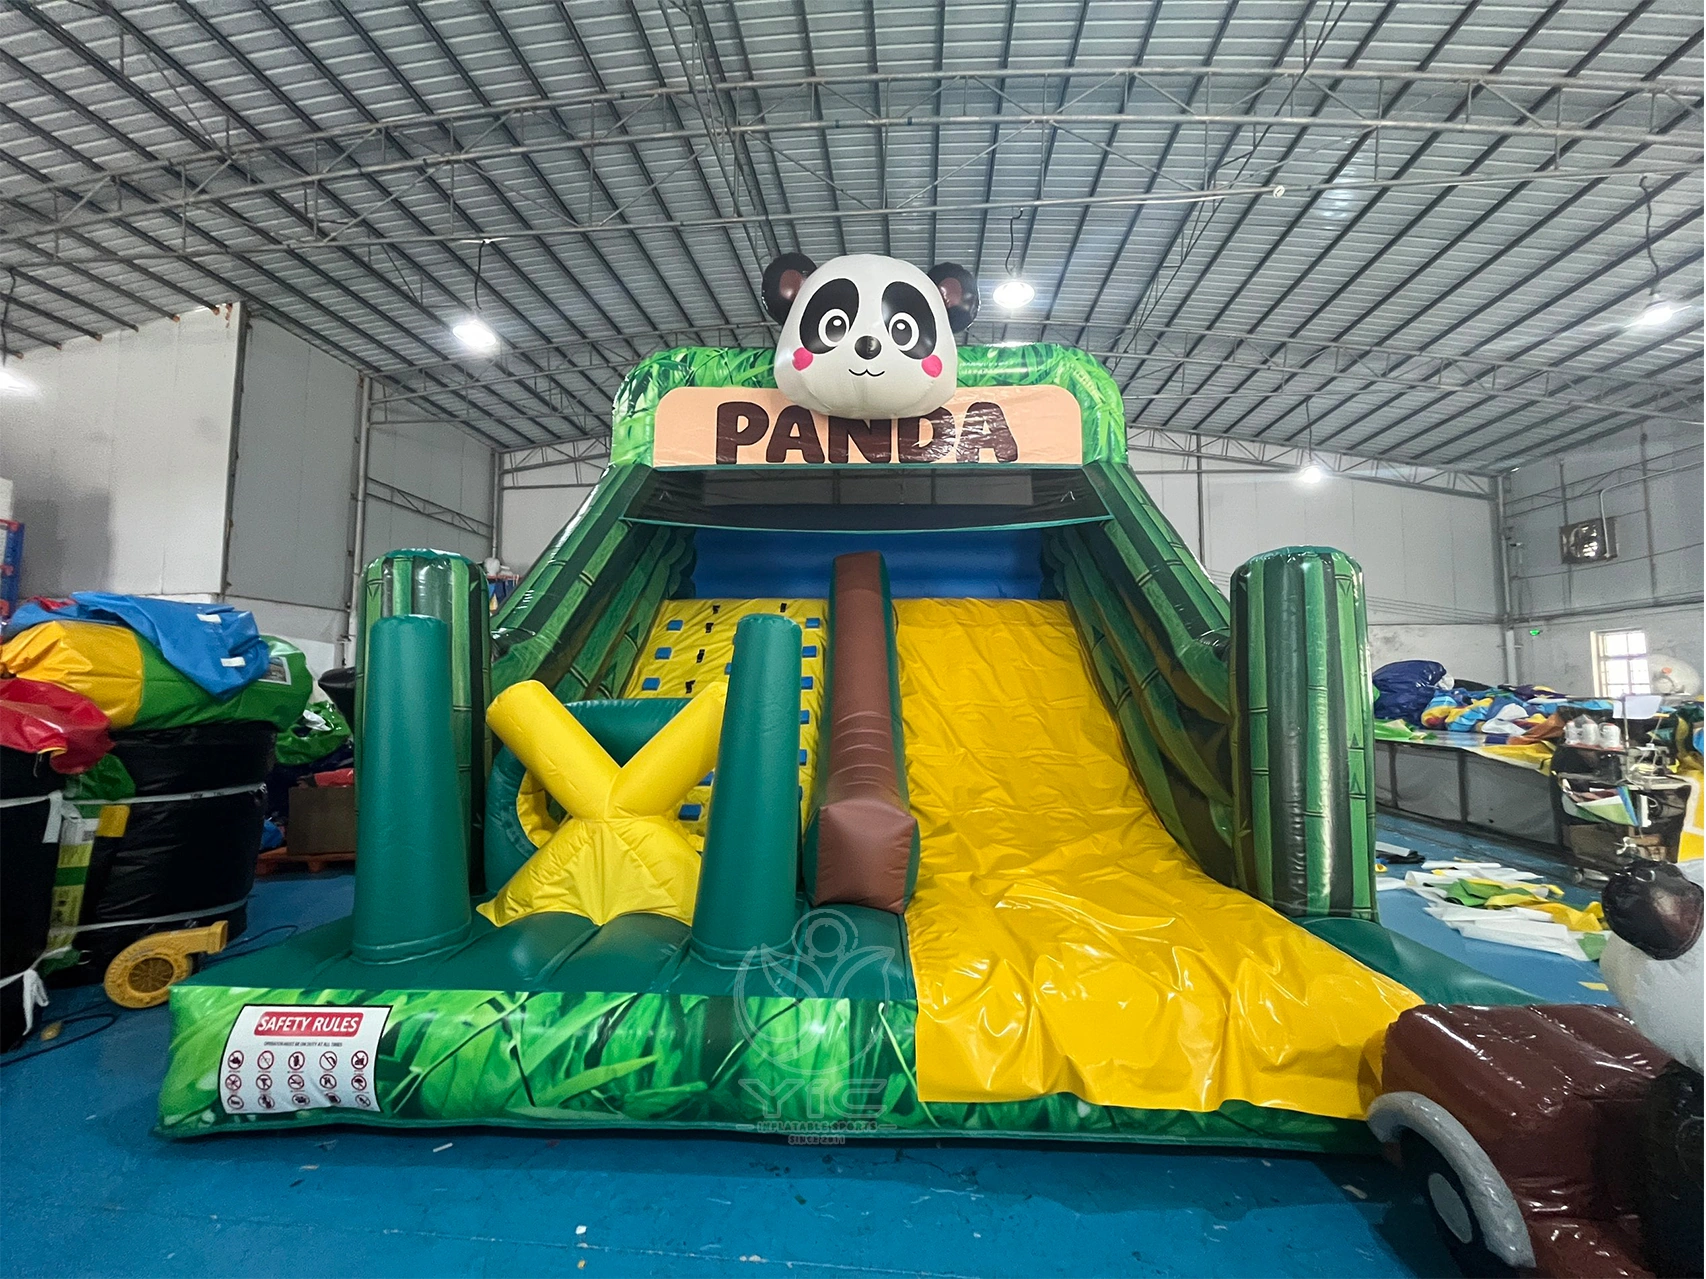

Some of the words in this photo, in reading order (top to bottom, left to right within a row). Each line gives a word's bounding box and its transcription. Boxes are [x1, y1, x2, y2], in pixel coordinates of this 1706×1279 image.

[716, 401, 1019, 464] PANDA
[257, 1016, 312, 1032] SAFETY
[312, 1017, 359, 1032] RULES
